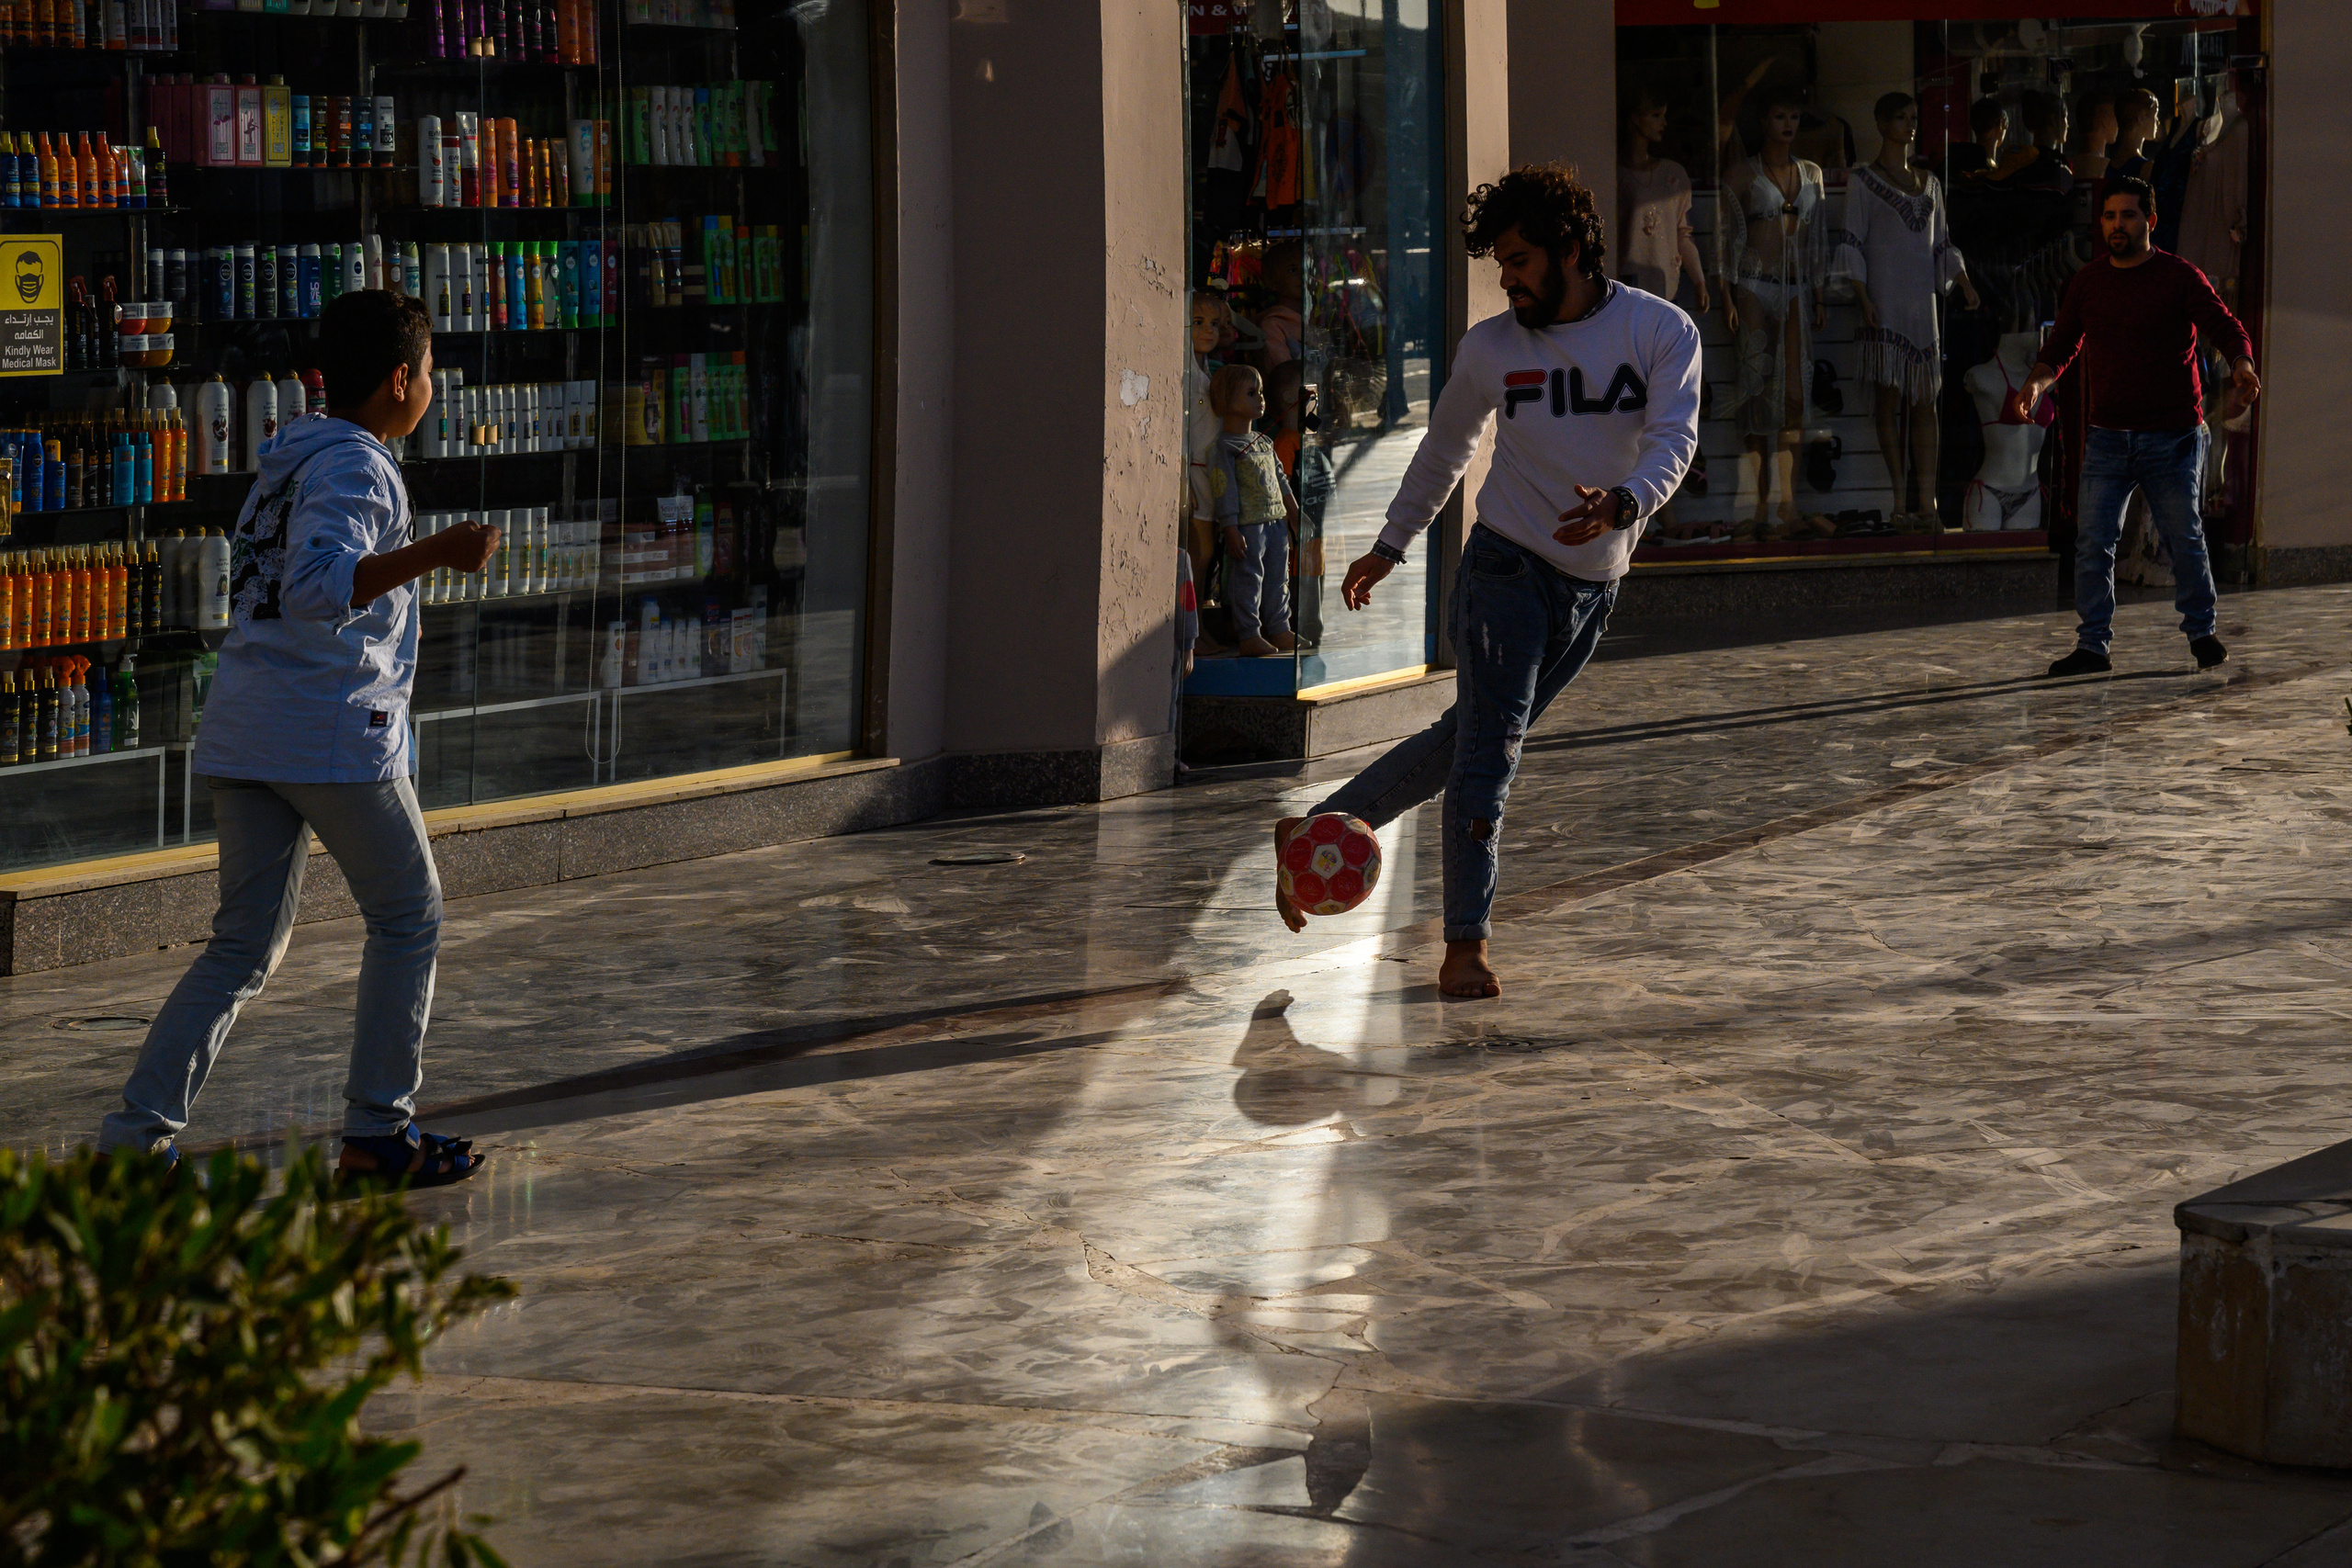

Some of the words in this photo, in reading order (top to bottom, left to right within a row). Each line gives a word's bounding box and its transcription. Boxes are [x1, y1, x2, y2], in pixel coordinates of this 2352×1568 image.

[1211, 5, 1227, 17] &
[33, 315, 54, 326] يجب
[5, 344, 31, 358] Kindly
[32, 344, 54, 355] Wear
[2, 357, 34, 368] Medical
[35, 356, 57, 367] Mask
[1503, 363, 1648, 420] FILA
